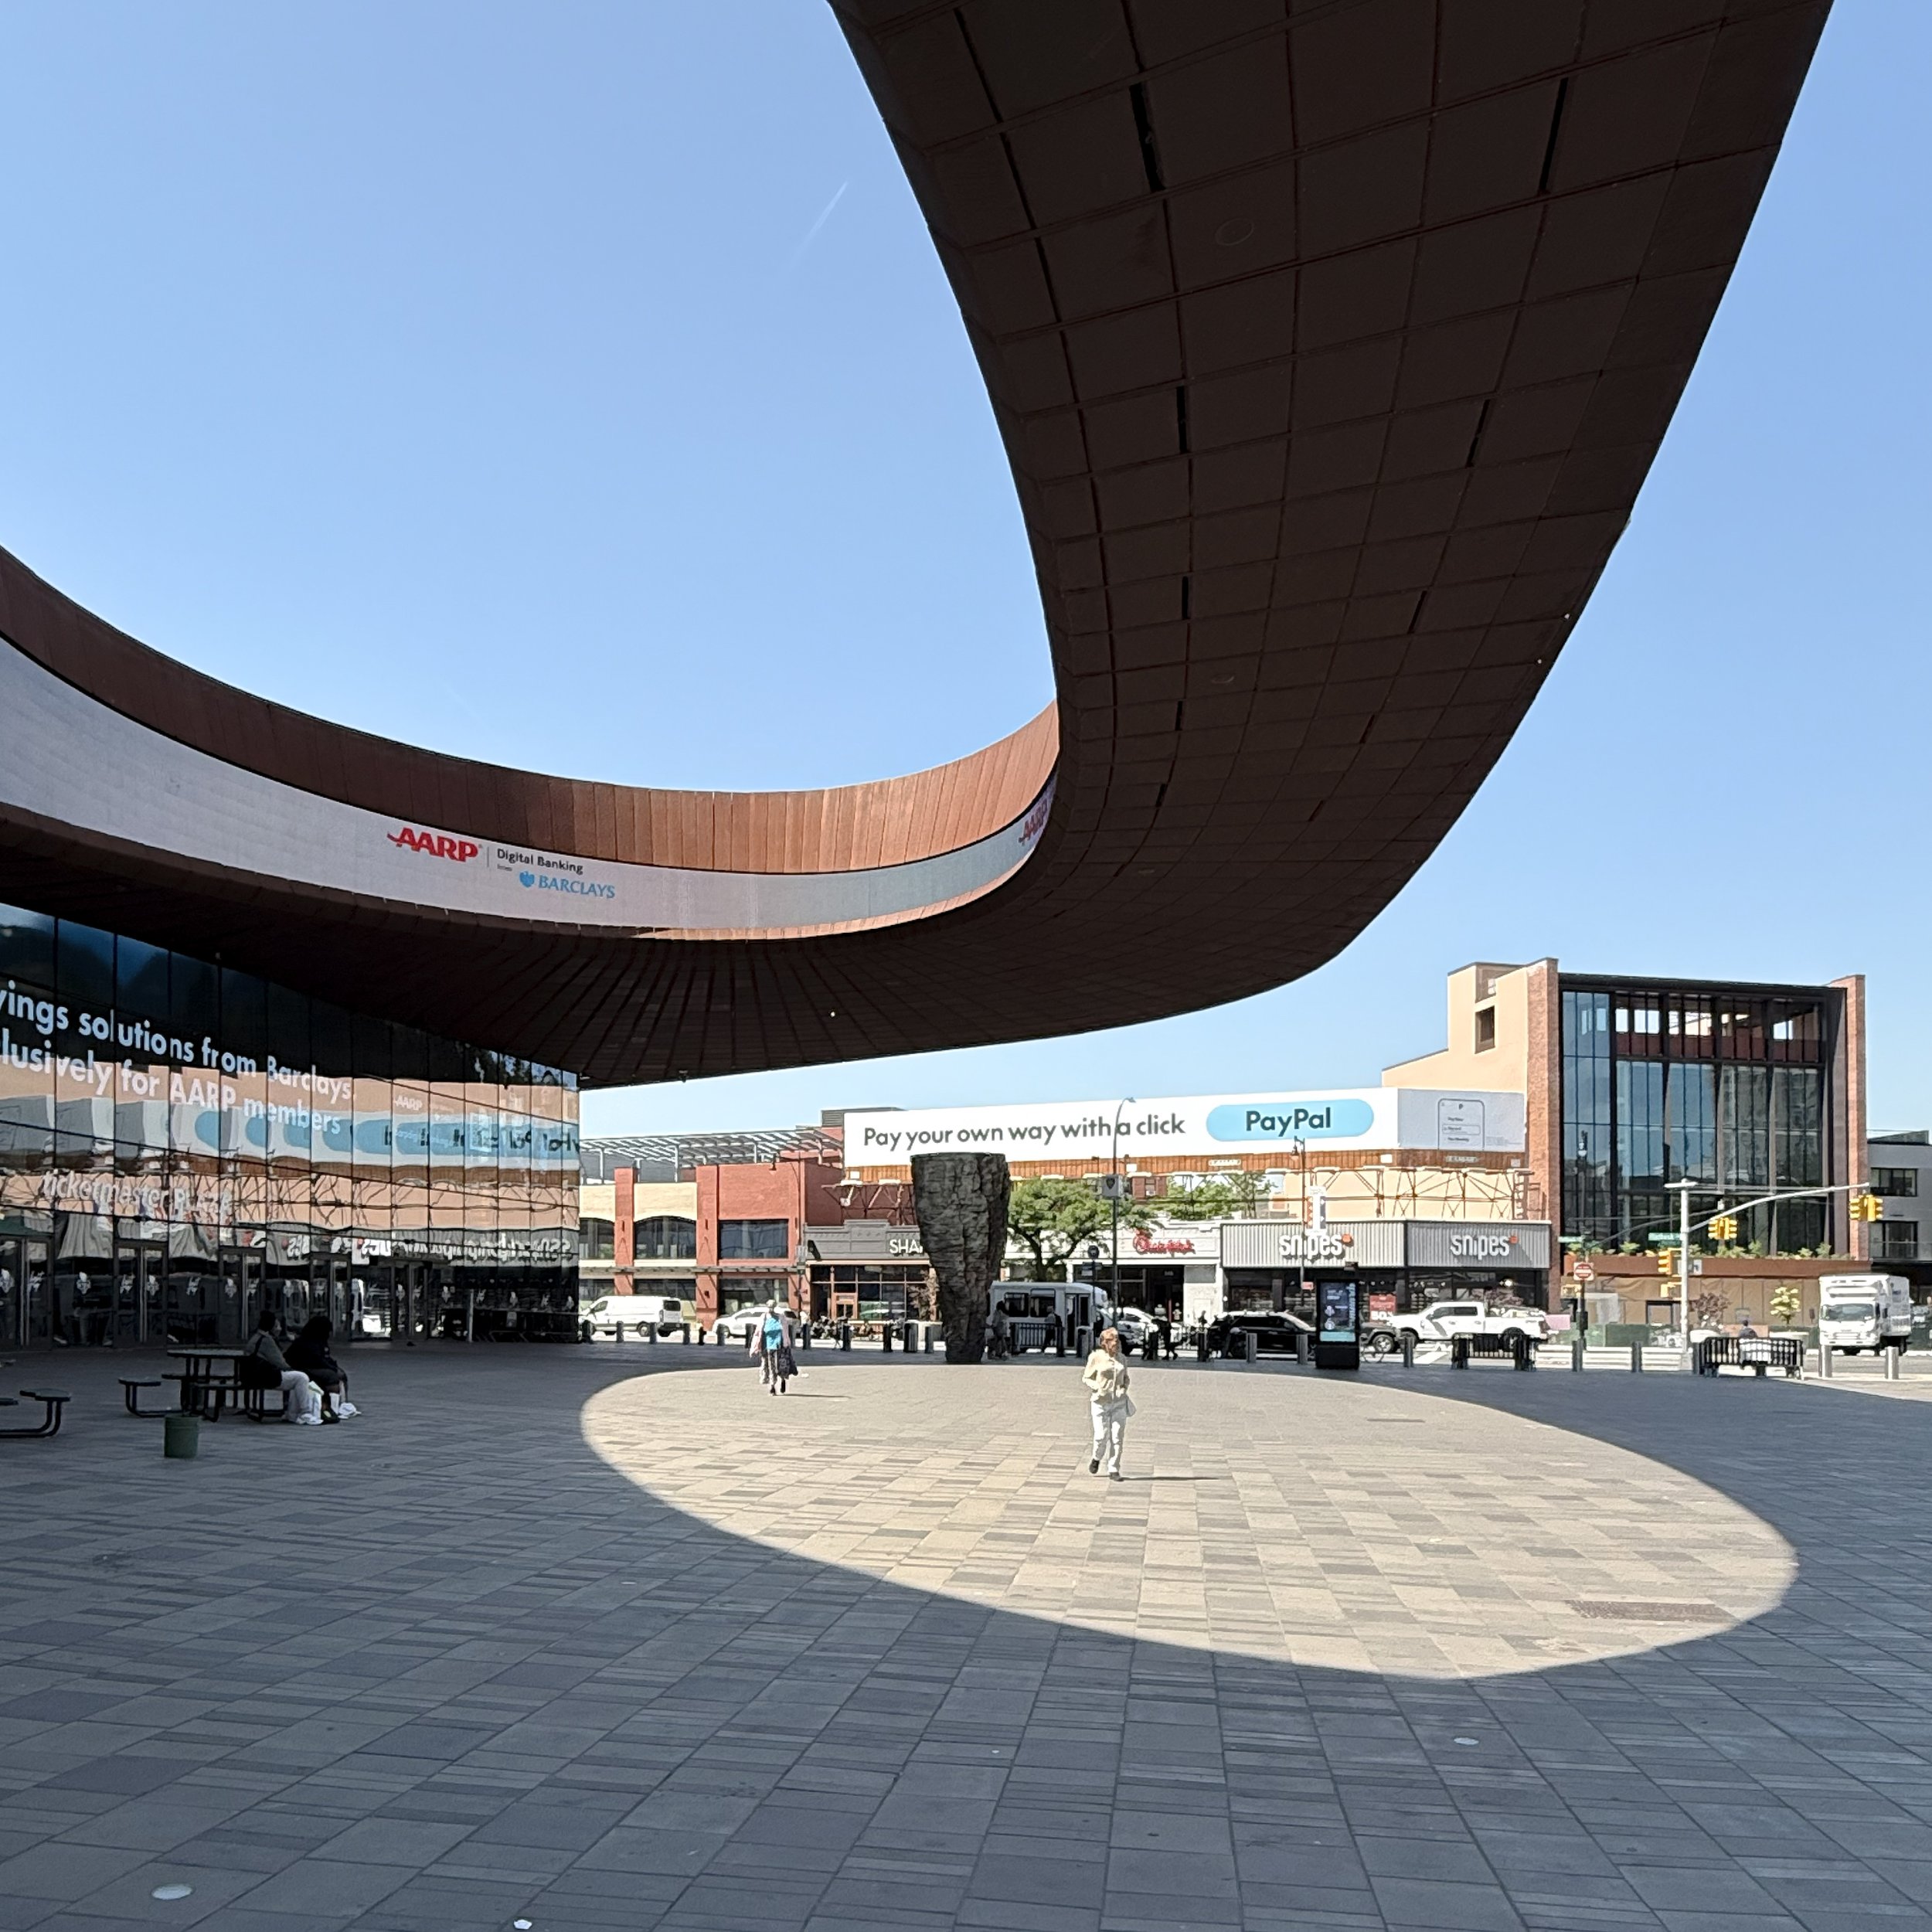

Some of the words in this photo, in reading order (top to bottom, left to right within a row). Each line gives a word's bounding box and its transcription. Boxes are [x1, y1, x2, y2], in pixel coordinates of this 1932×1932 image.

[386, 827, 478, 862] AARP
[497, 848, 533, 865] Digital
[537, 855, 583, 875] Banking
[539, 875, 615, 899] BARCLAYS
[79, 1009, 194, 1063] solutions
[202, 1036, 257, 1077] from
[121, 1059, 160, 1097] for
[170, 1072, 236, 1113] AARP
[243, 1097, 341, 1134] members
[864, 1127, 903, 1152] Pay
[906, 1128, 954, 1151] your
[957, 1127, 1004, 1143] own
[1007, 1124, 1058, 1146] way
[1060, 1116, 1111, 1138] with
[1116, 1121, 1131, 1136] a
[1136, 1114, 1185, 1135] click
[1246, 1107, 1331, 1137] PayPal
[42, 1168, 169, 1207] ticketmaster
[889, 1238, 923, 1254] SHA
[1279, 1234, 1343, 1260] snipes
[1451, 1234, 1510, 1260] snipes
